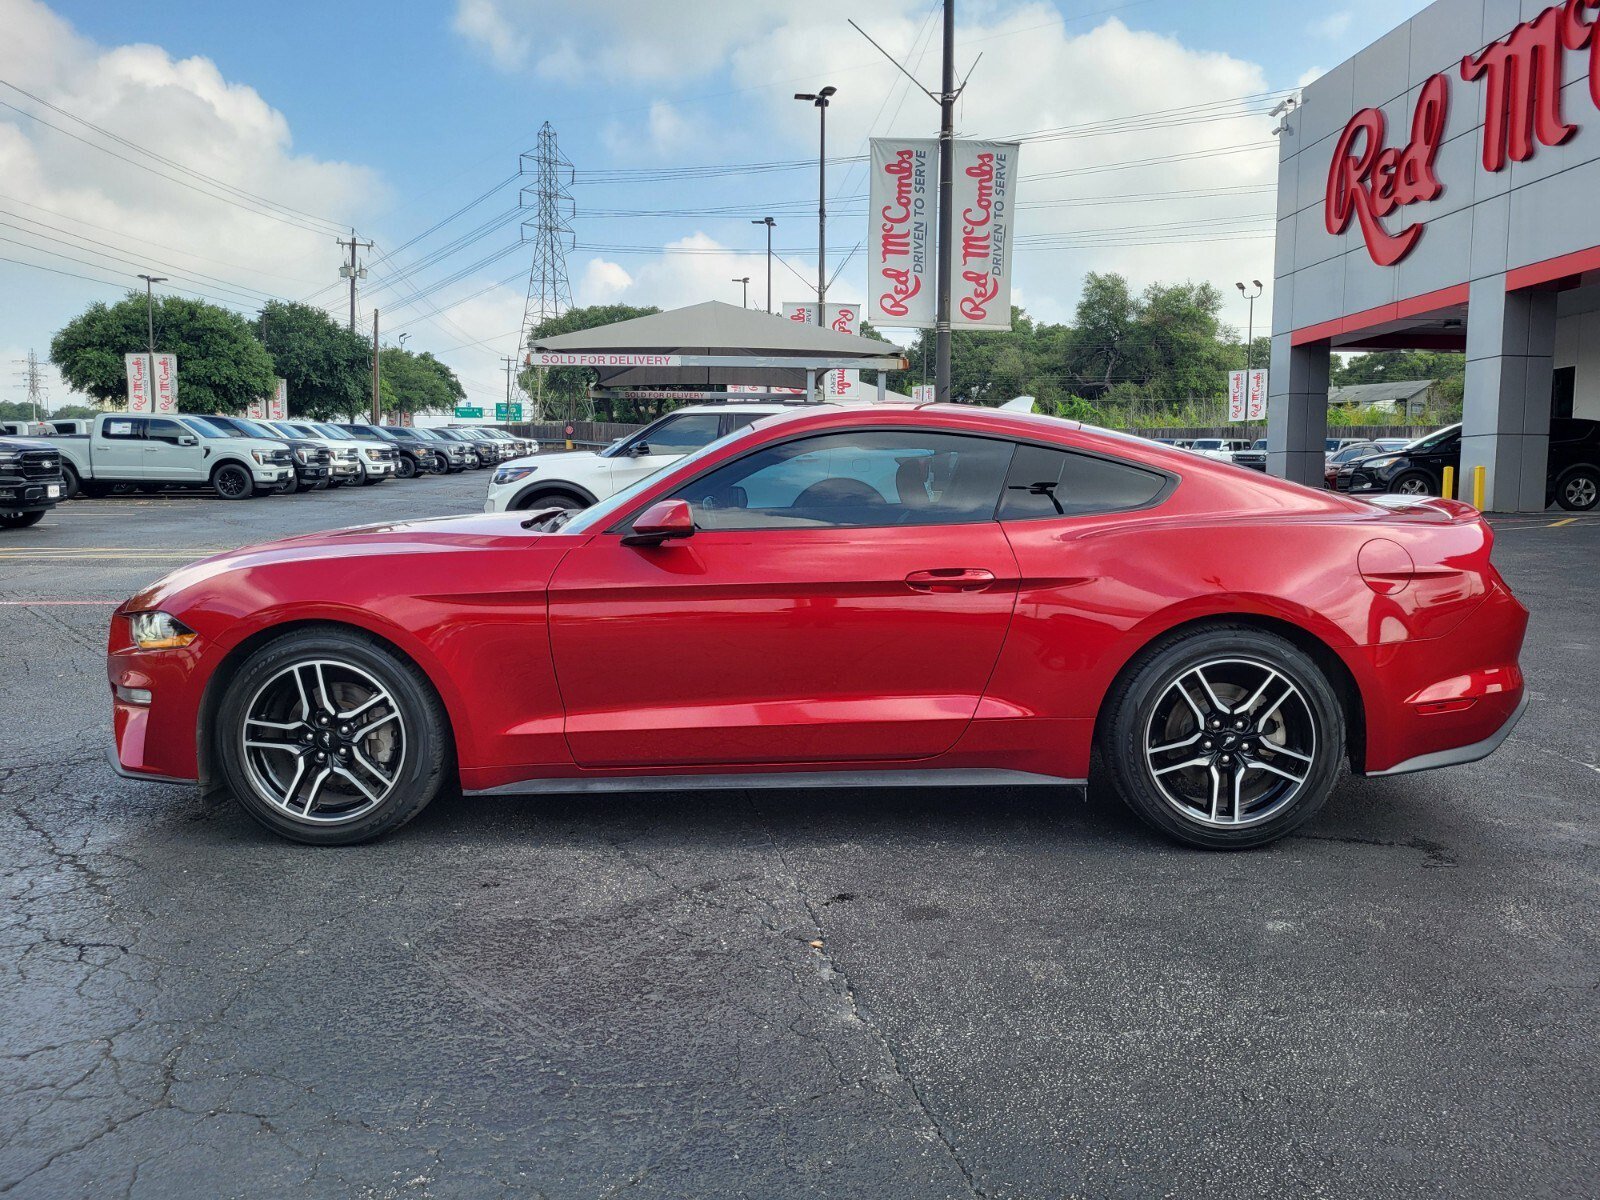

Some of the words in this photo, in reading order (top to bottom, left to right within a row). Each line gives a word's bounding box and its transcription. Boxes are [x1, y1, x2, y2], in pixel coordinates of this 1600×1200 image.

[914, 150, 926, 194] SERVE
[995, 153, 1006, 197] SERVE
[1325, 73, 1448, 267] Red
[881, 150, 914, 263] McCombs
[914, 198, 925, 217] TO
[962, 153, 994, 267] McCombs
[994, 201, 1005, 219] TO
[913, 221, 925, 274] DRIVEN
[992, 223, 1003, 276] DRIVEN
[880, 268, 922, 317] Red
[960, 270, 999, 321] Red
[541, 354, 576, 365] SOLD
[580, 355, 606, 365] FOR
[609, 355, 671, 366] DELIVERY
[624, 391, 646, 399] SOLD
